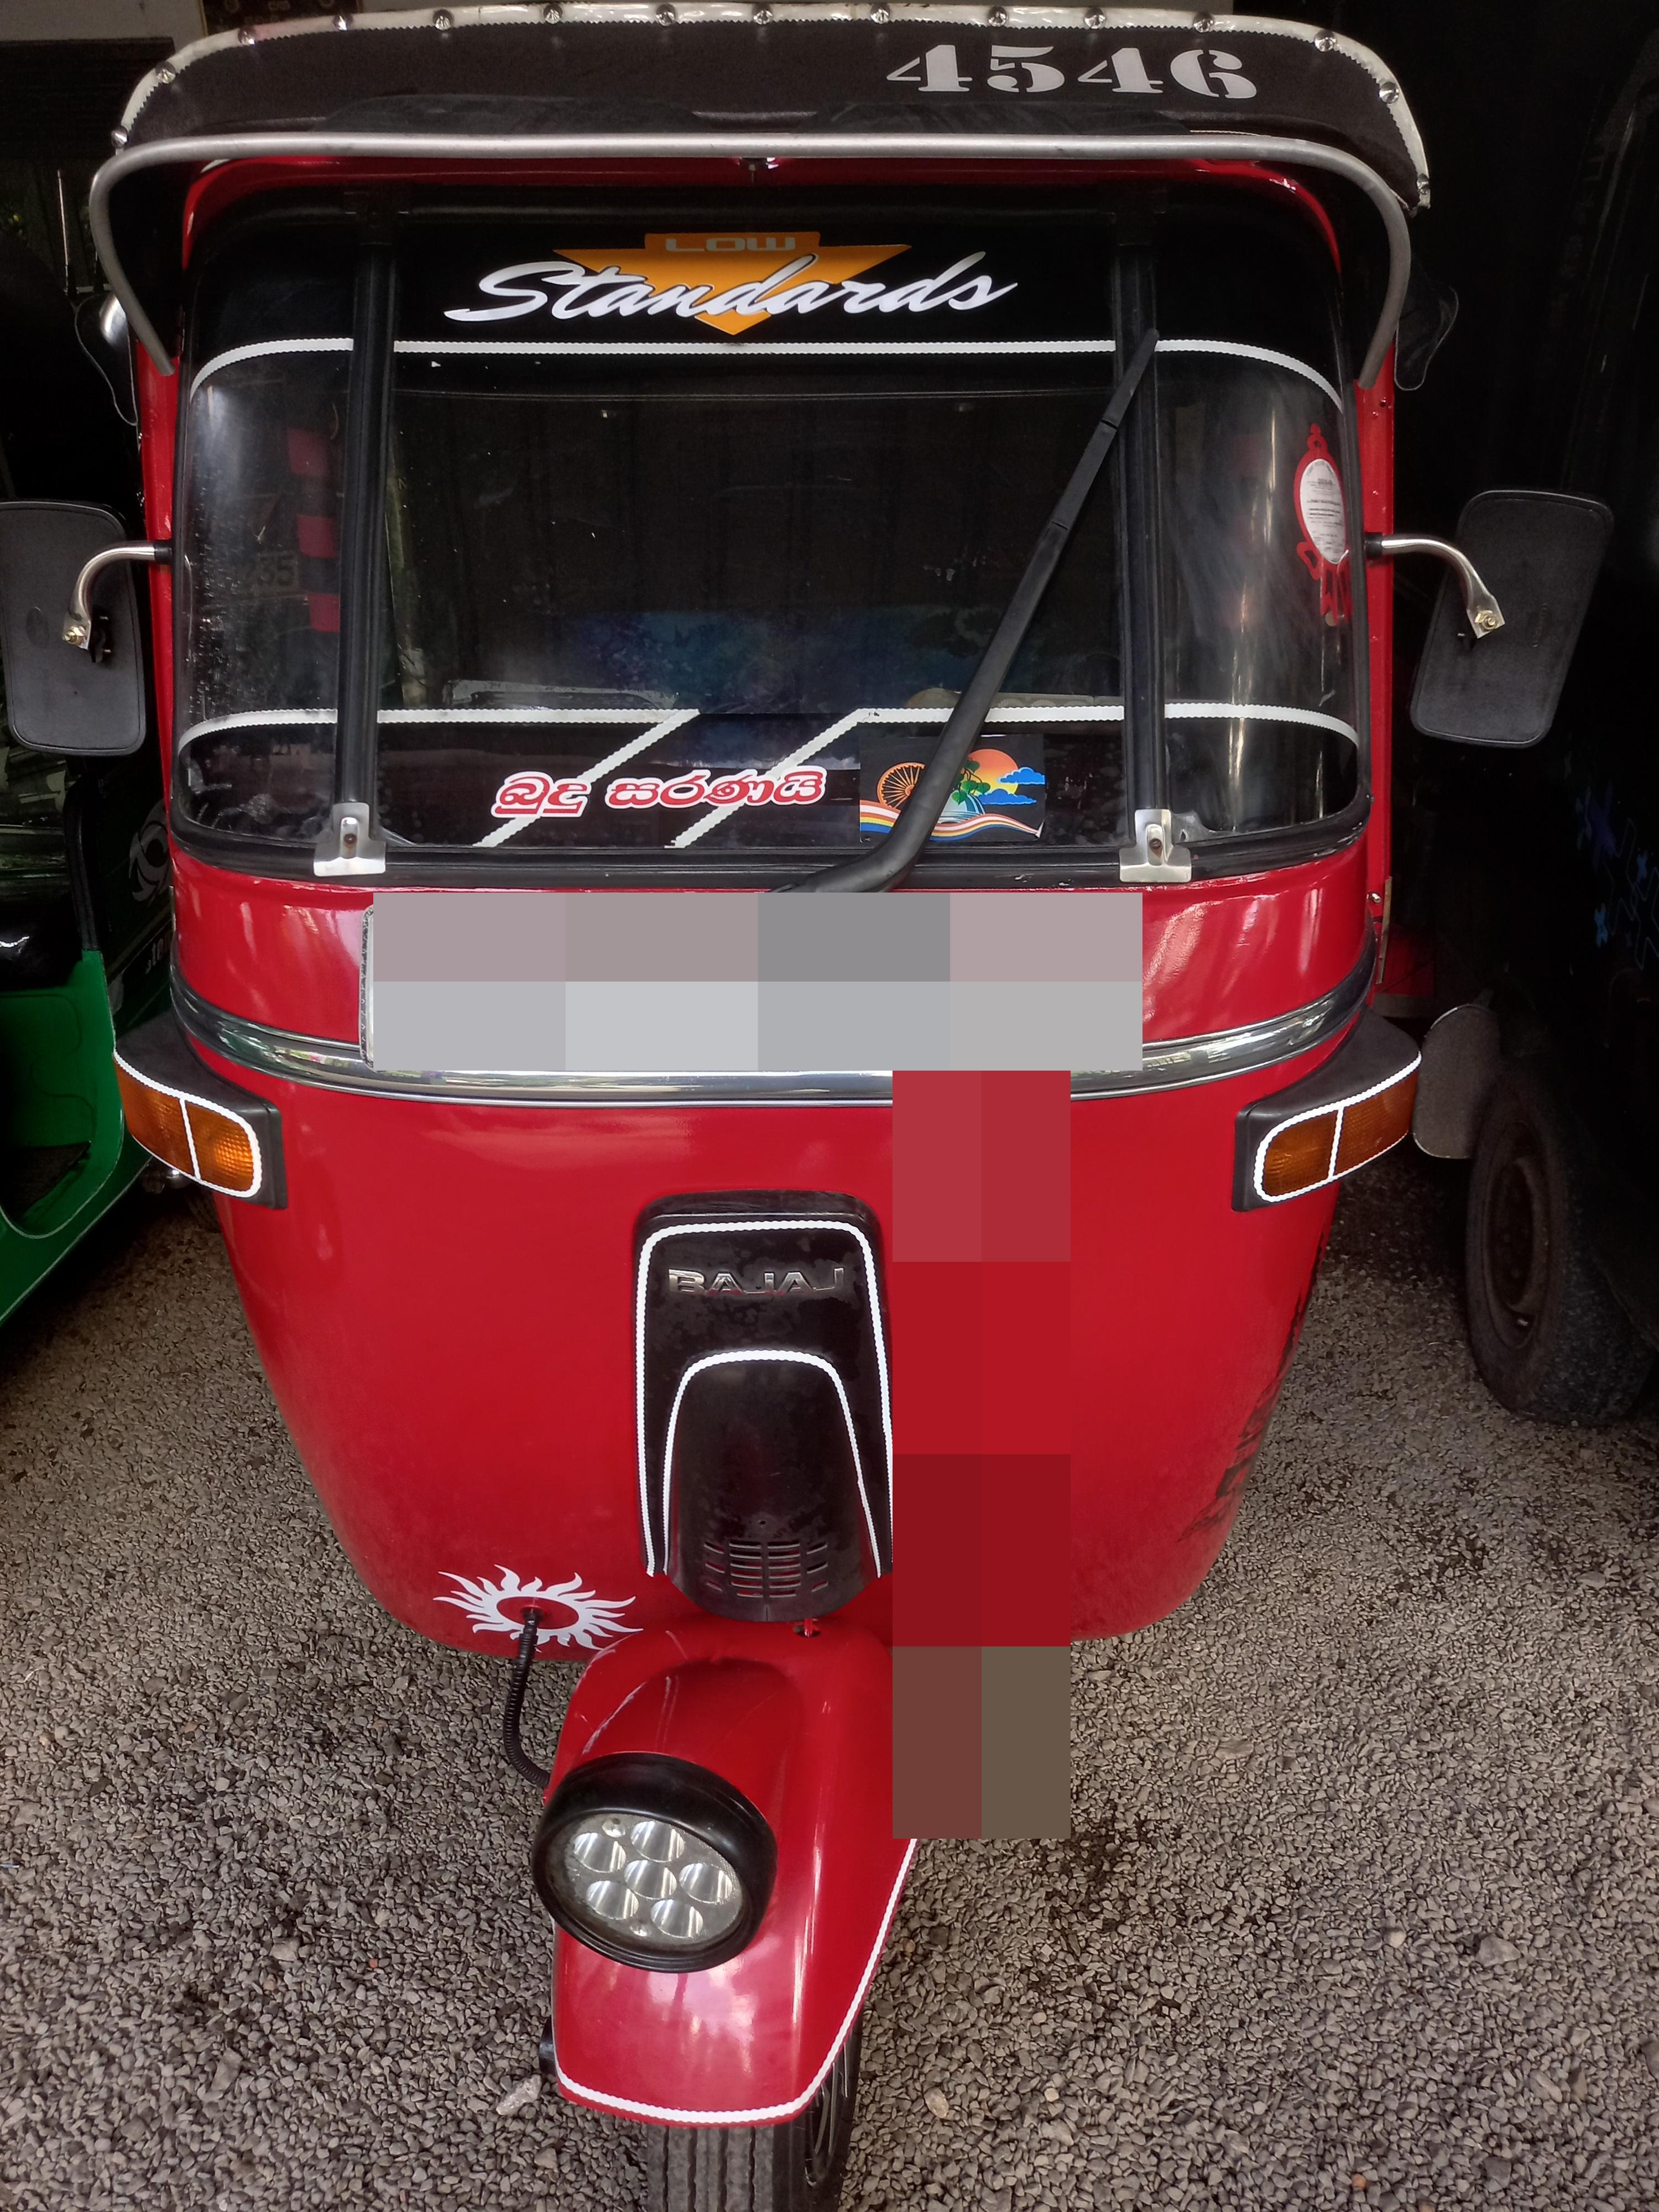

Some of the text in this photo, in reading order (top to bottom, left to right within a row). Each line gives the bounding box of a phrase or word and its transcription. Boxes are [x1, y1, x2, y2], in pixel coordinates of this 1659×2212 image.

[886, 44, 1257, 99] 4546
[665, 236, 795, 252] LOW
[444, 251, 1019, 322] Standards
[668, 1267, 845, 1297] BAJAJ
